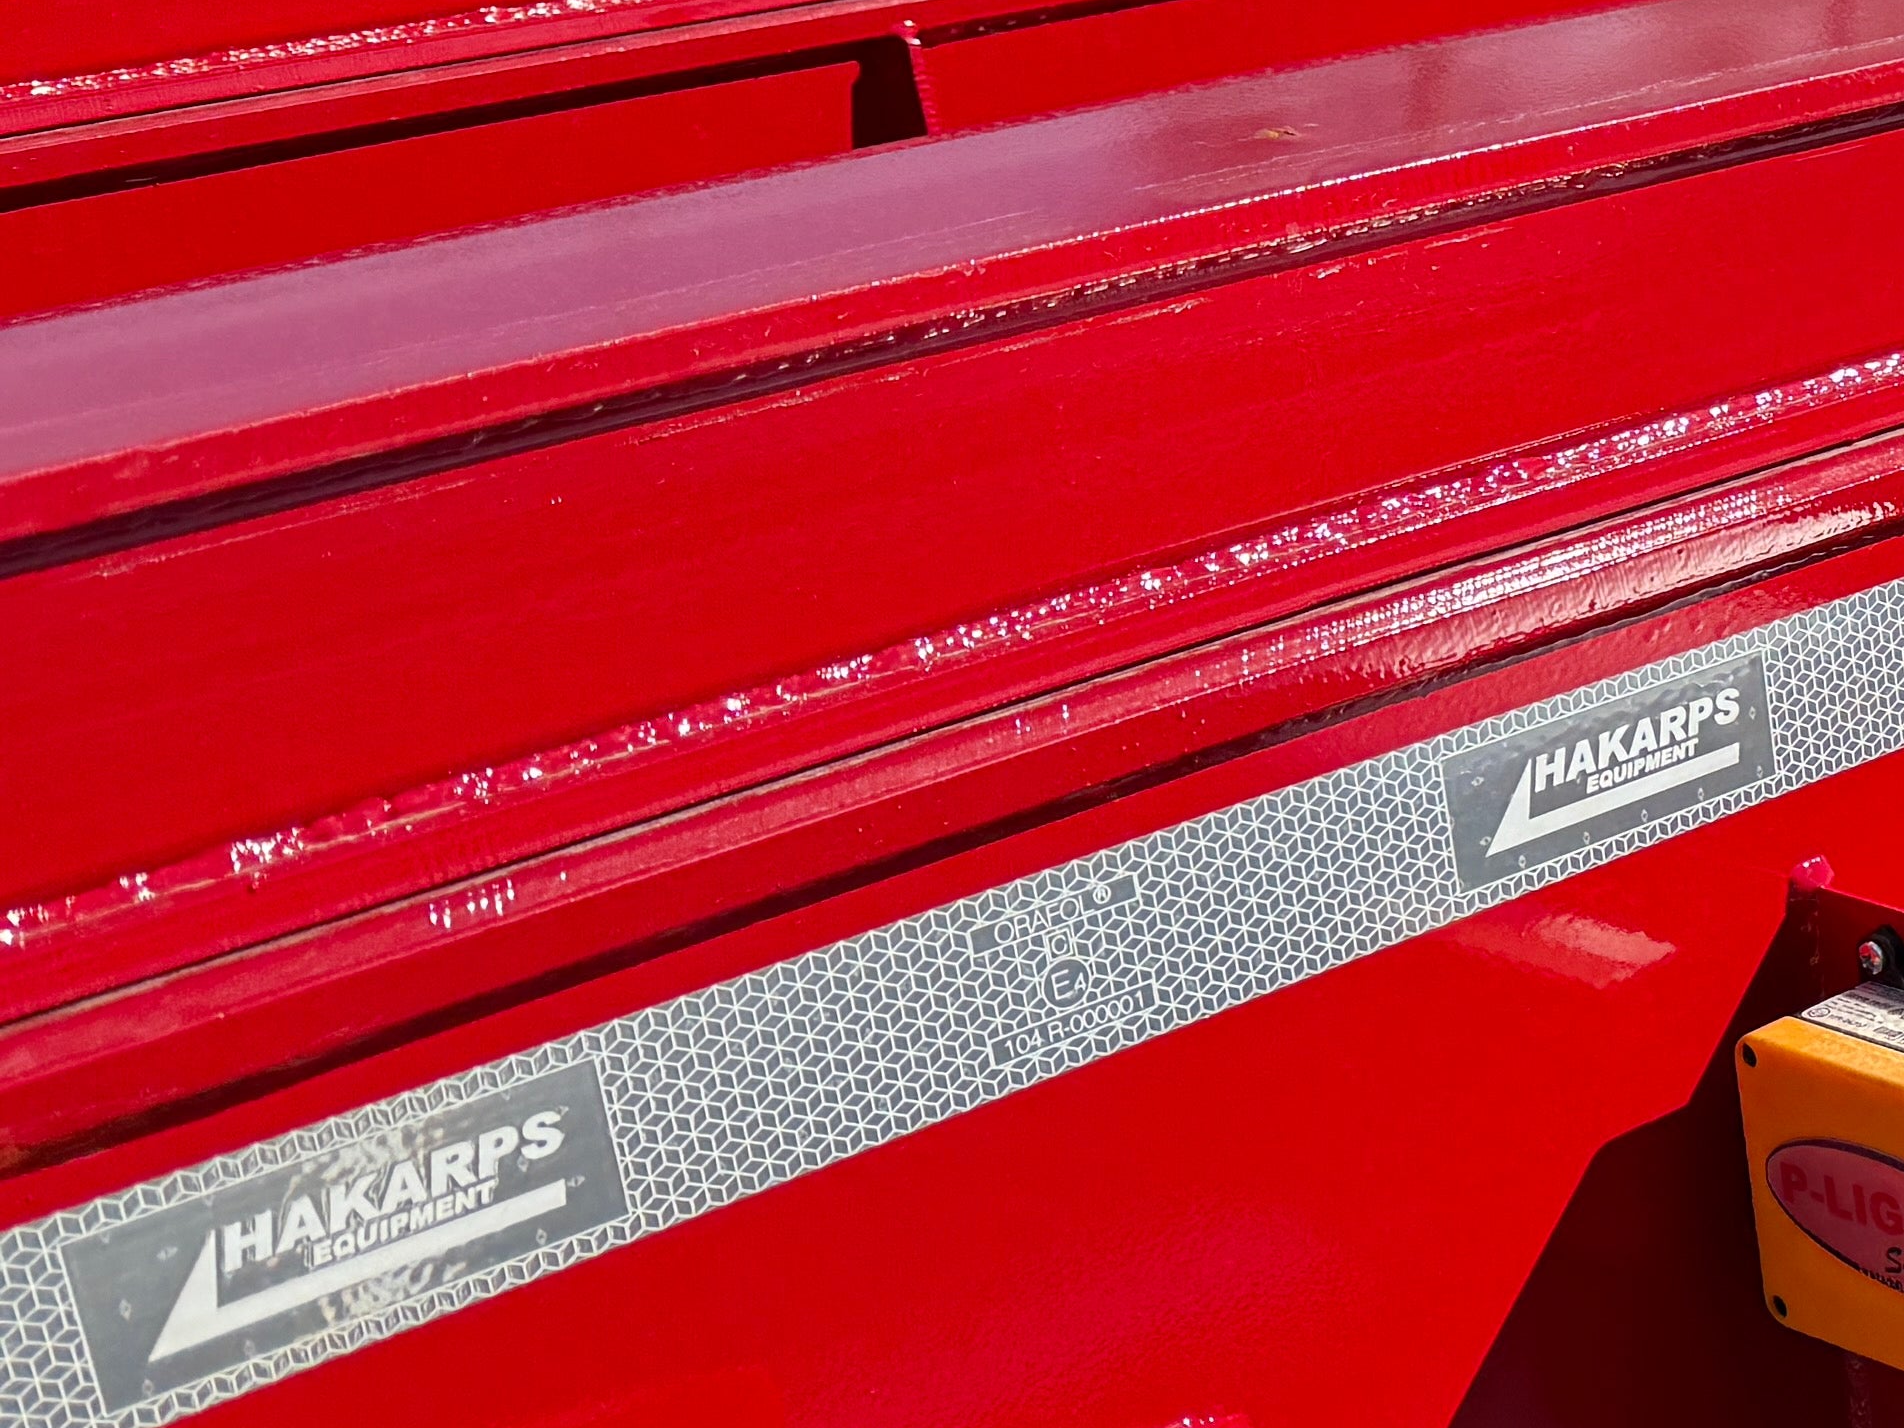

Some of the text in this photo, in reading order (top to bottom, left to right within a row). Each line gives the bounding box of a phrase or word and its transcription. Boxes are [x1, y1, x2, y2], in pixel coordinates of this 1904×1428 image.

[1533, 687, 1741, 793] HAKARPS
[1586, 738, 1699, 794] EQUIPMENT
[1050, 934, 1068, 956] C
[1004, 990, 1146, 1059] 104 R-000001
[224, 1110, 566, 1274] HAKARPS
[312, 1178, 499, 1268] EQUIPMENT
